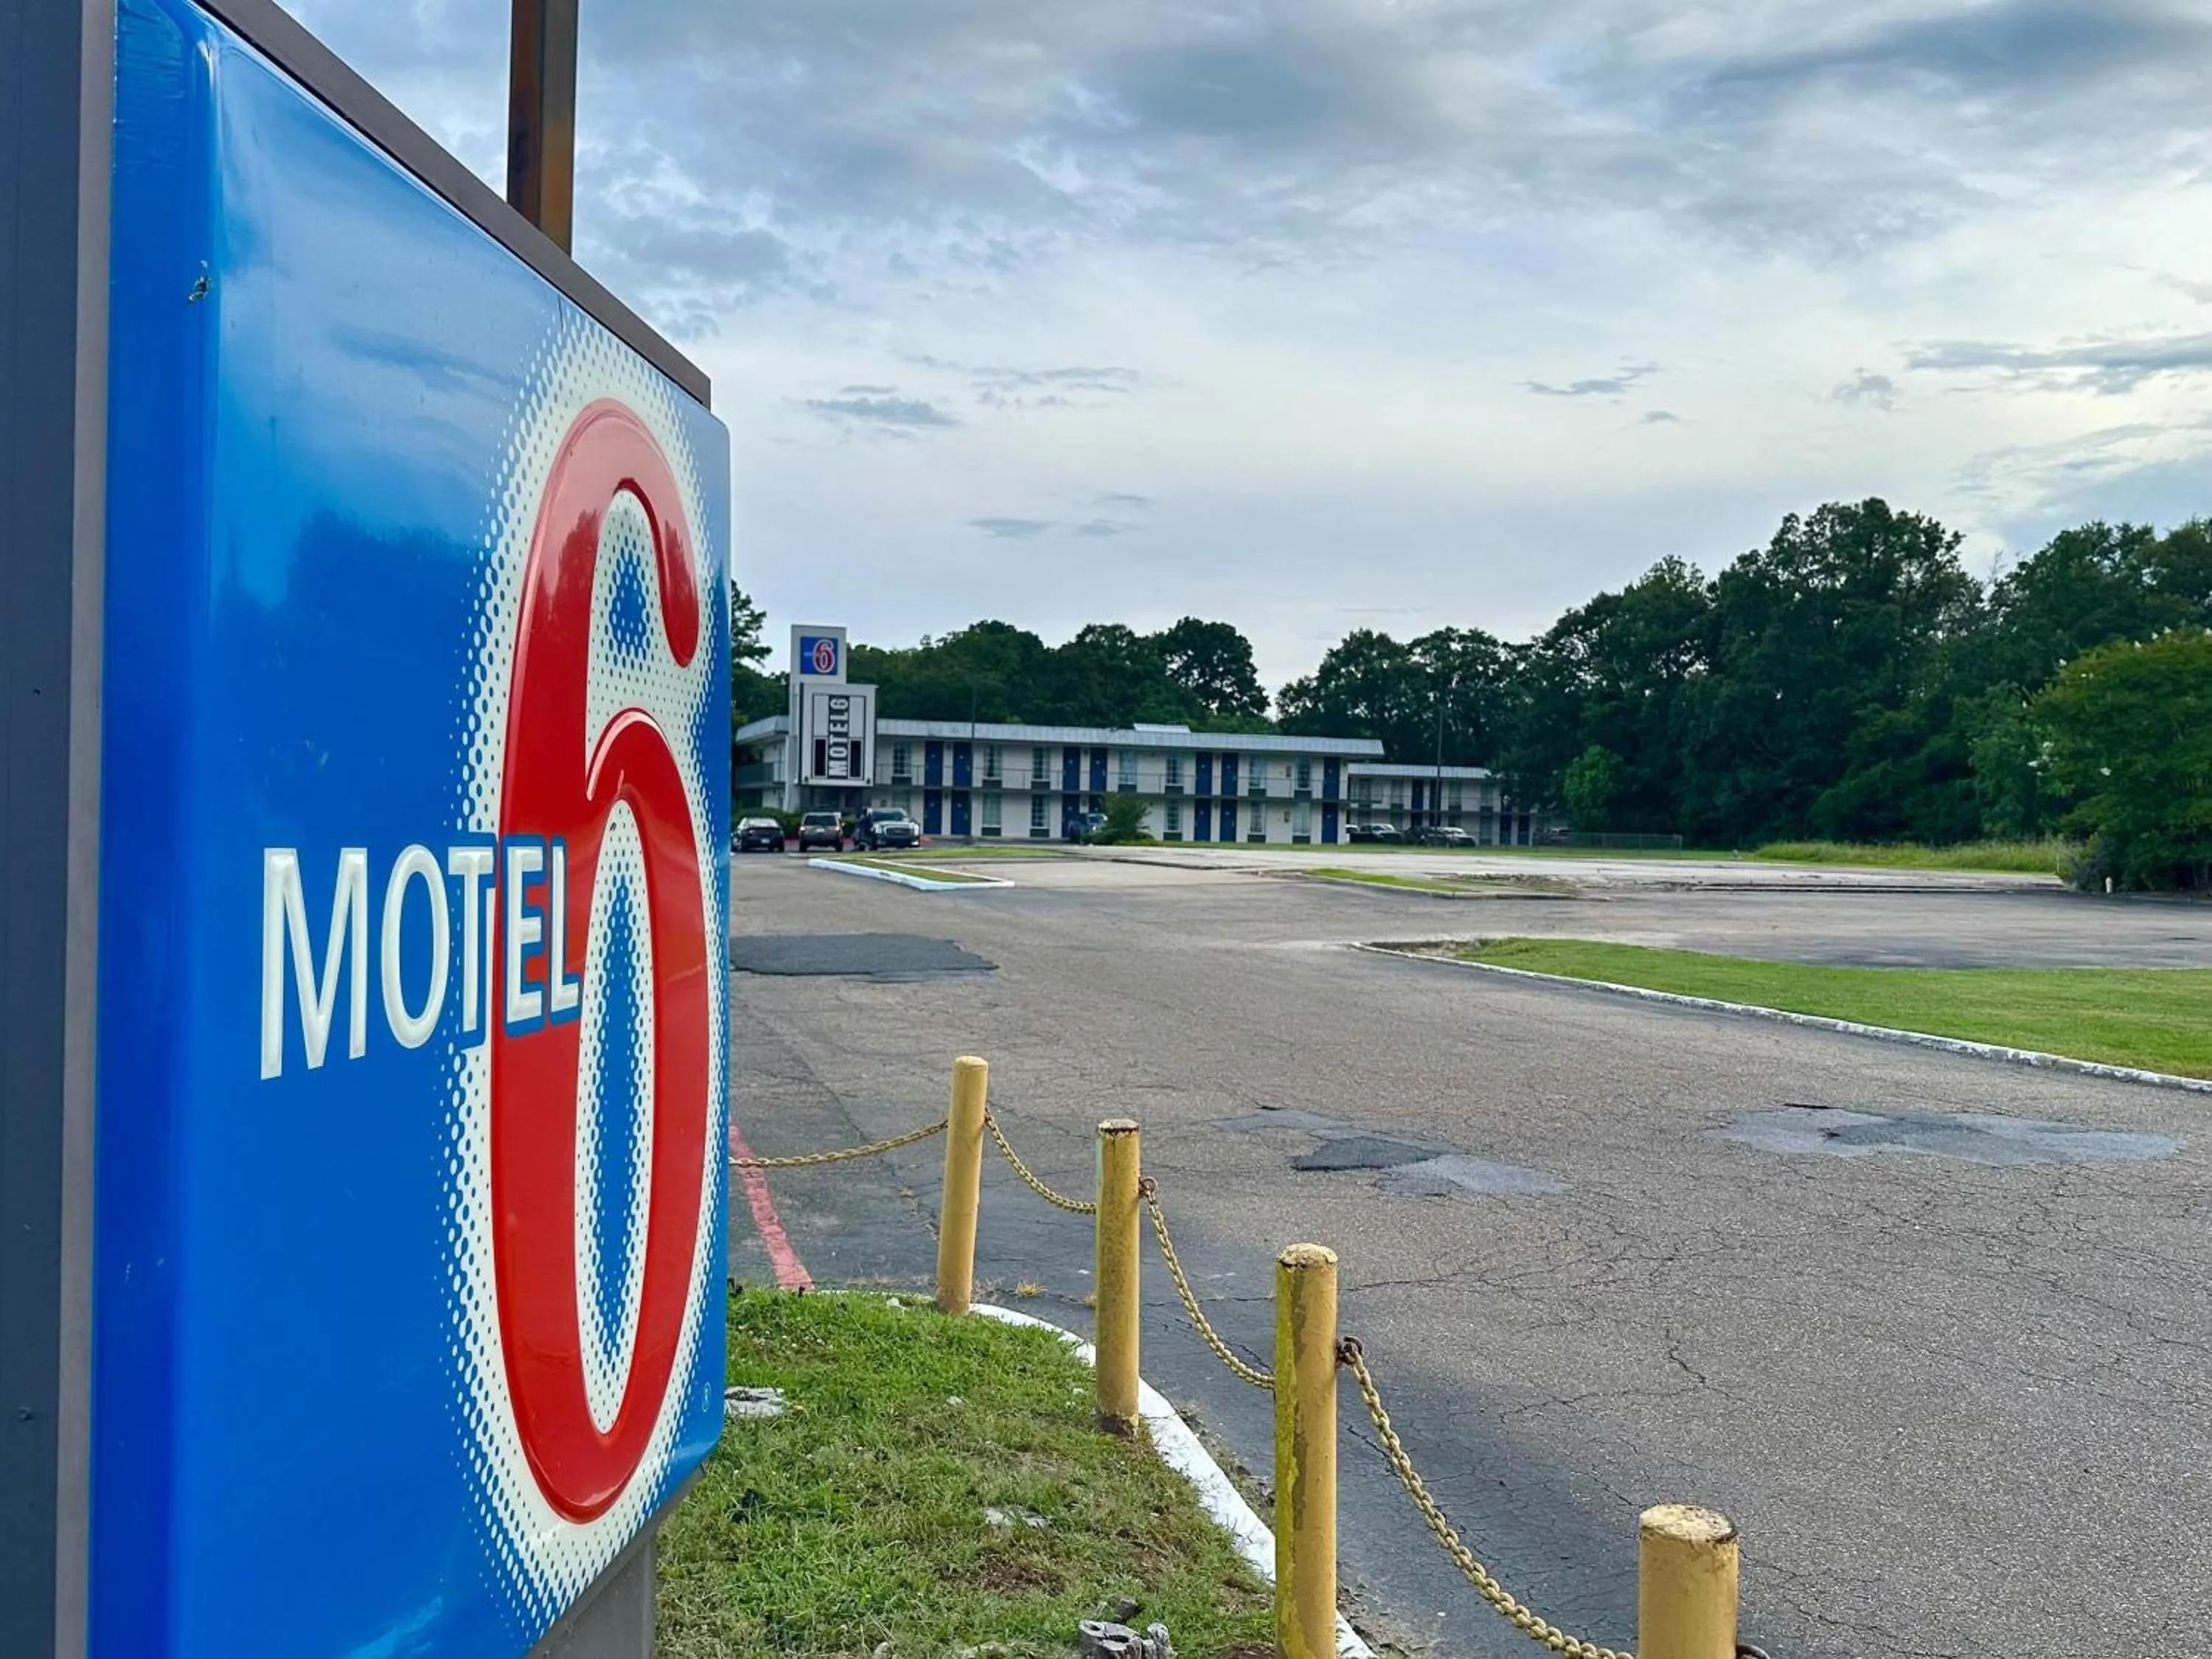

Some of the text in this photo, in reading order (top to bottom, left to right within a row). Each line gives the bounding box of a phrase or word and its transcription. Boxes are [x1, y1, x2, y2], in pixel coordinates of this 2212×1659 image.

[814, 640, 834, 672] 6
[829, 698, 849, 776] MOTEL 6
[261, 399, 709, 1524] MOTEL 6
